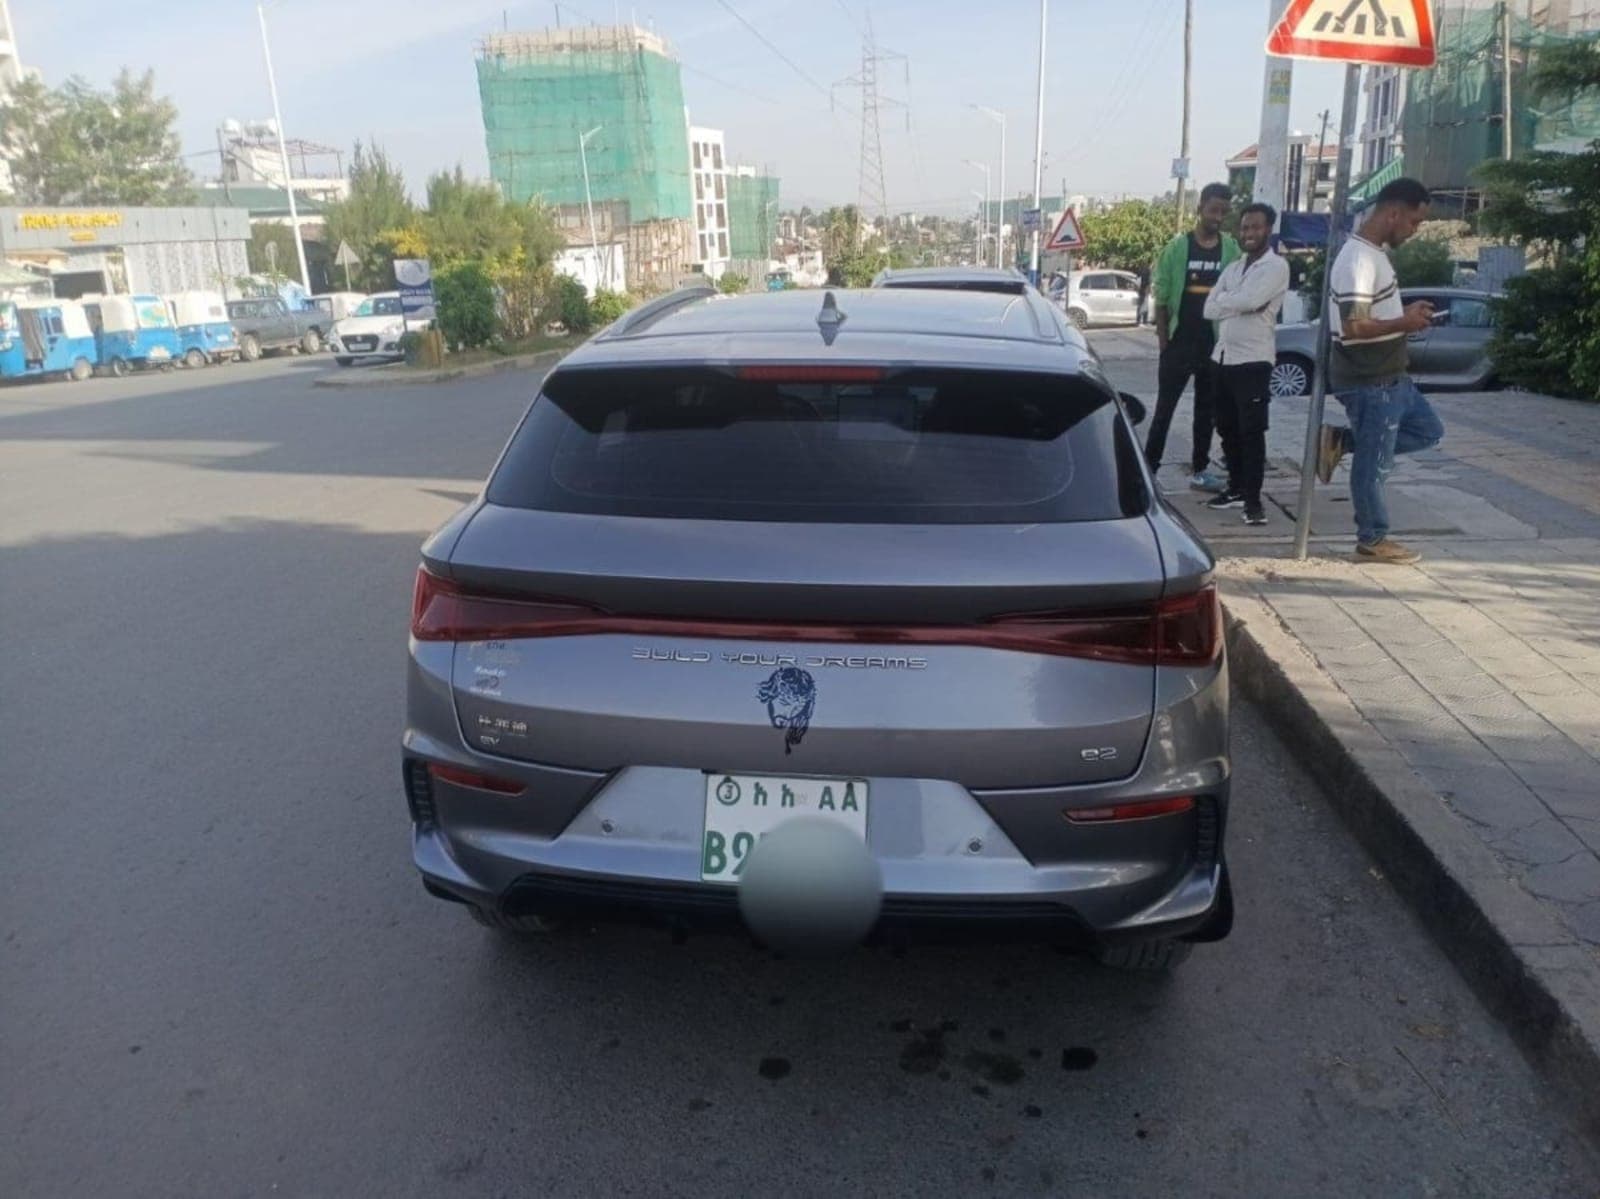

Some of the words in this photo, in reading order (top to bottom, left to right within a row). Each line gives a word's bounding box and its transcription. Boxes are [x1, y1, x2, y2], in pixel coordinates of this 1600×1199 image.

[632, 647, 710, 662] BUILD
[721, 652, 798, 667] YOUR
[806, 656, 928, 669] DREAMS
[818, 782, 859, 812] AA
